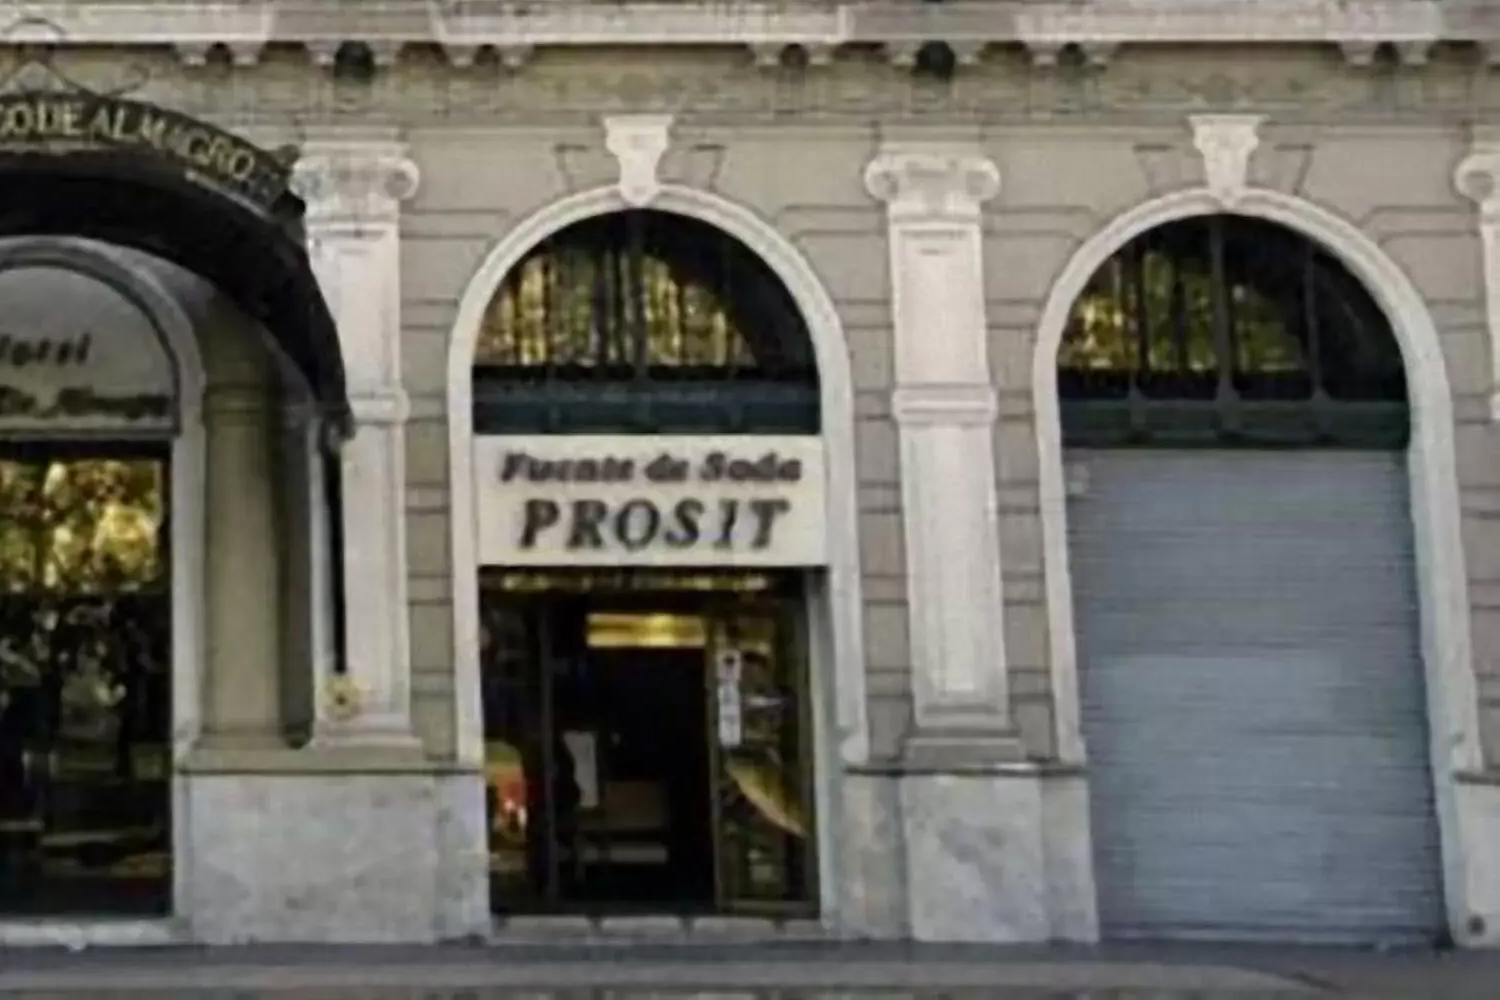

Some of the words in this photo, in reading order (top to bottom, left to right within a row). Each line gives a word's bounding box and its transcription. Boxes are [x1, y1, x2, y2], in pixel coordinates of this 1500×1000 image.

[36, 100, 83, 136] DE
[644, 452, 690, 483] de
[518, 499, 792, 549] PROSIT
